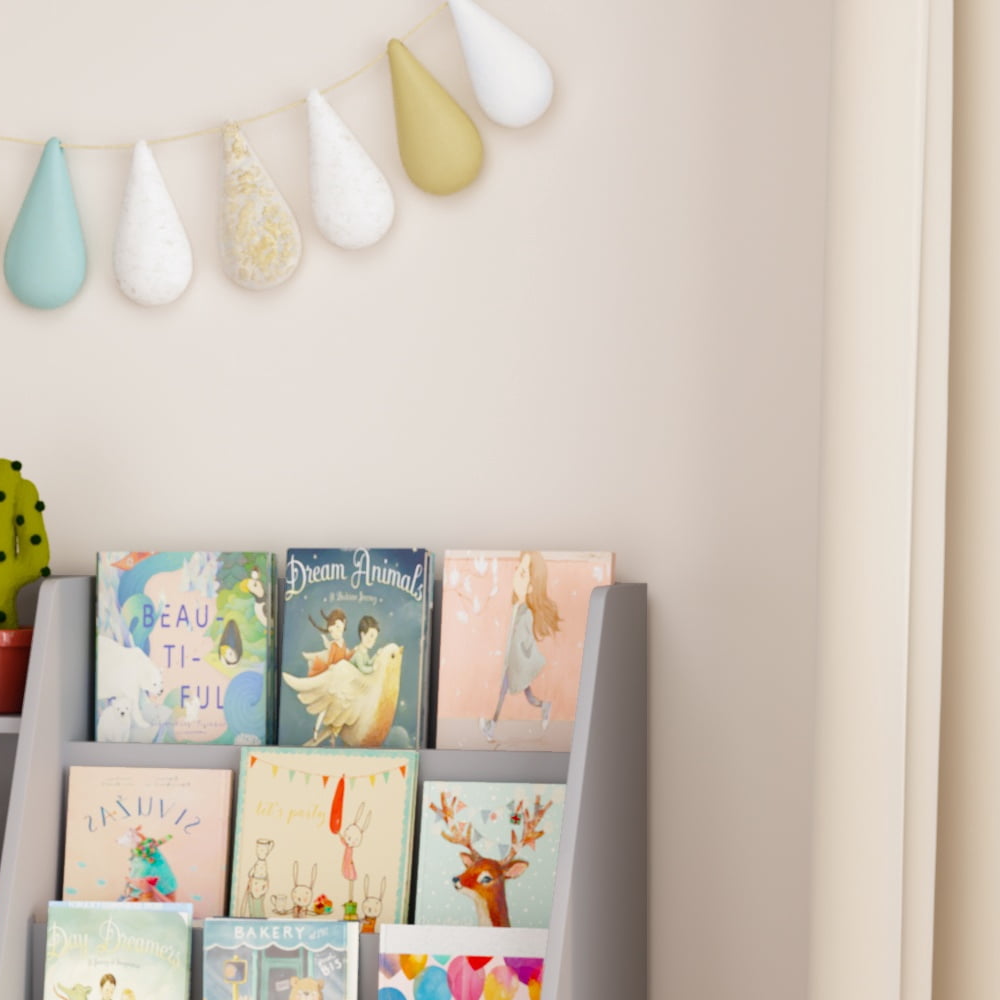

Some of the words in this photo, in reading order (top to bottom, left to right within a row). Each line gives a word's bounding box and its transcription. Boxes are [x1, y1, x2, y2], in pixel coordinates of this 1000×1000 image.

[285, 554, 347, 602] Dream
[350, 547, 424, 602] Animals
[142, 603, 225, 628] BEAU-
[163, 644, 201, 669] TI-
[180, 685, 225, 710] FUL
[233, 925, 305, 939] BAKERY
